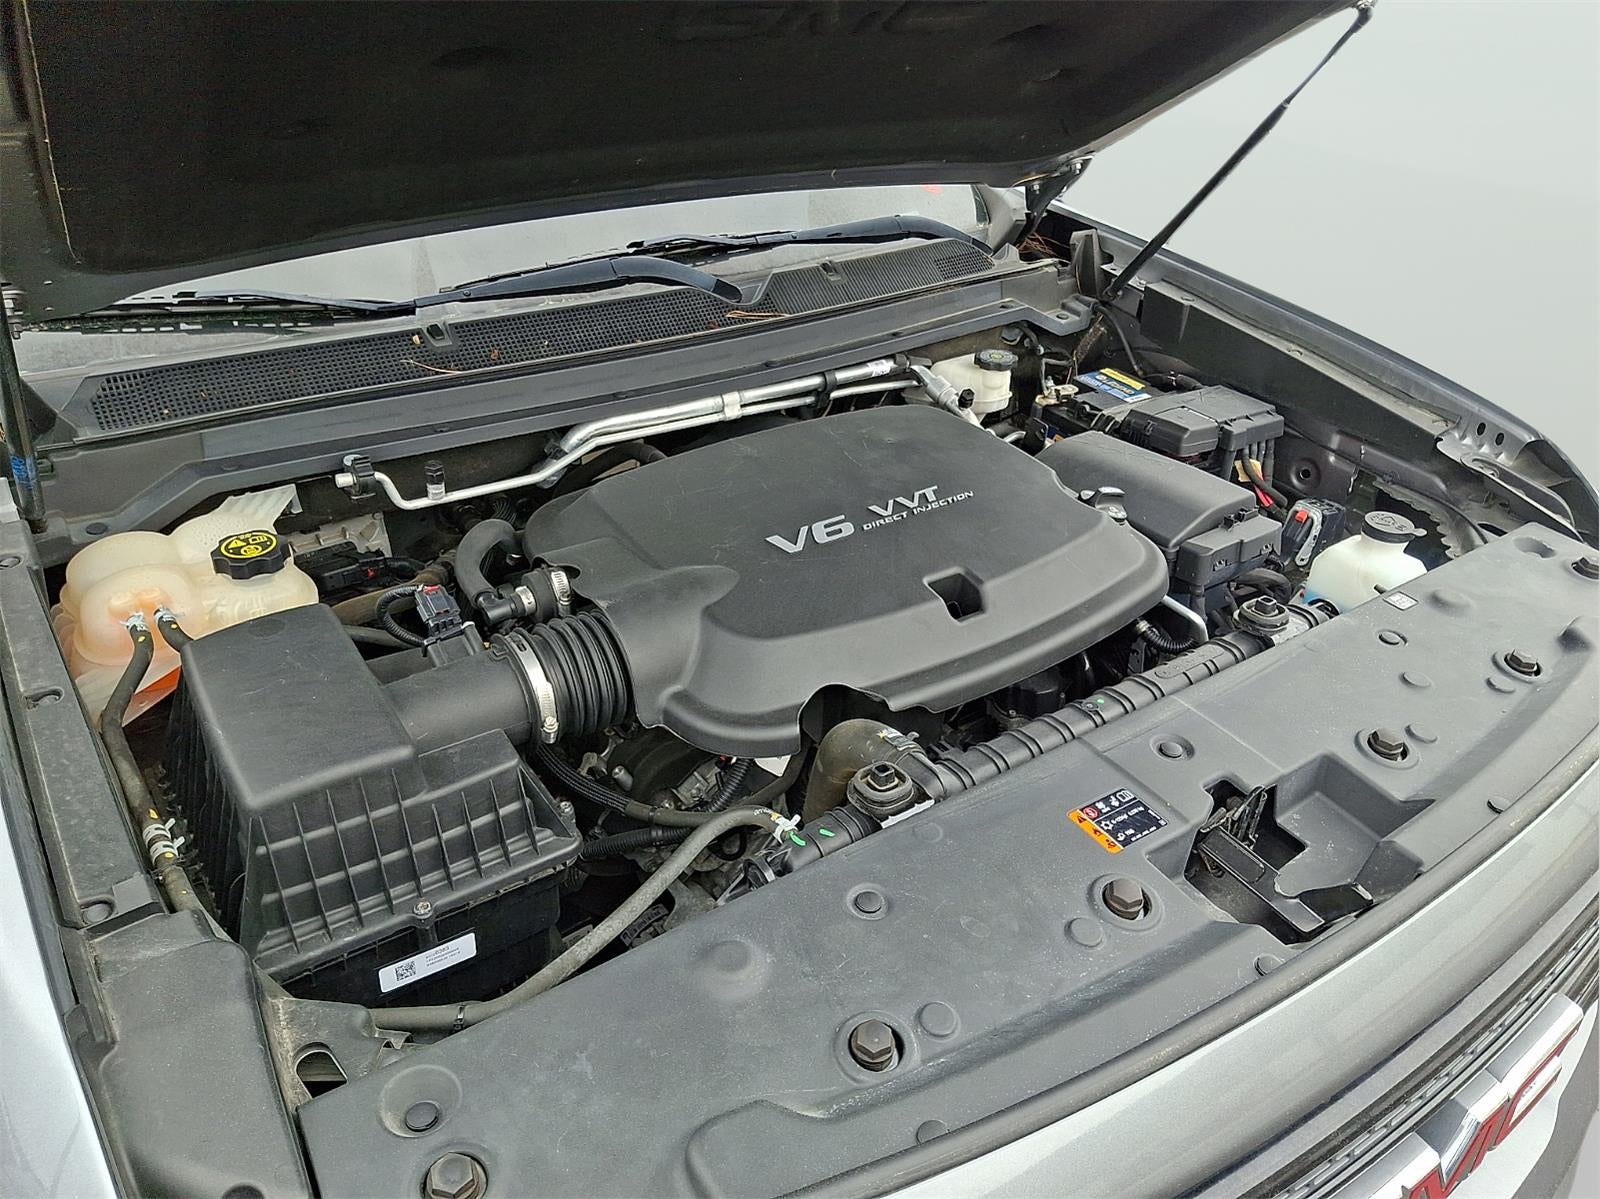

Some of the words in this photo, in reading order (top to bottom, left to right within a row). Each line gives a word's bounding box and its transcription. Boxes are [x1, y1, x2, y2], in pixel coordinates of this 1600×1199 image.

[862, 511, 908, 531] DIRECT
[913, 490, 974, 515] INJECTION
[867, 485, 938, 517] VVT
[765, 514, 855, 554] V6
